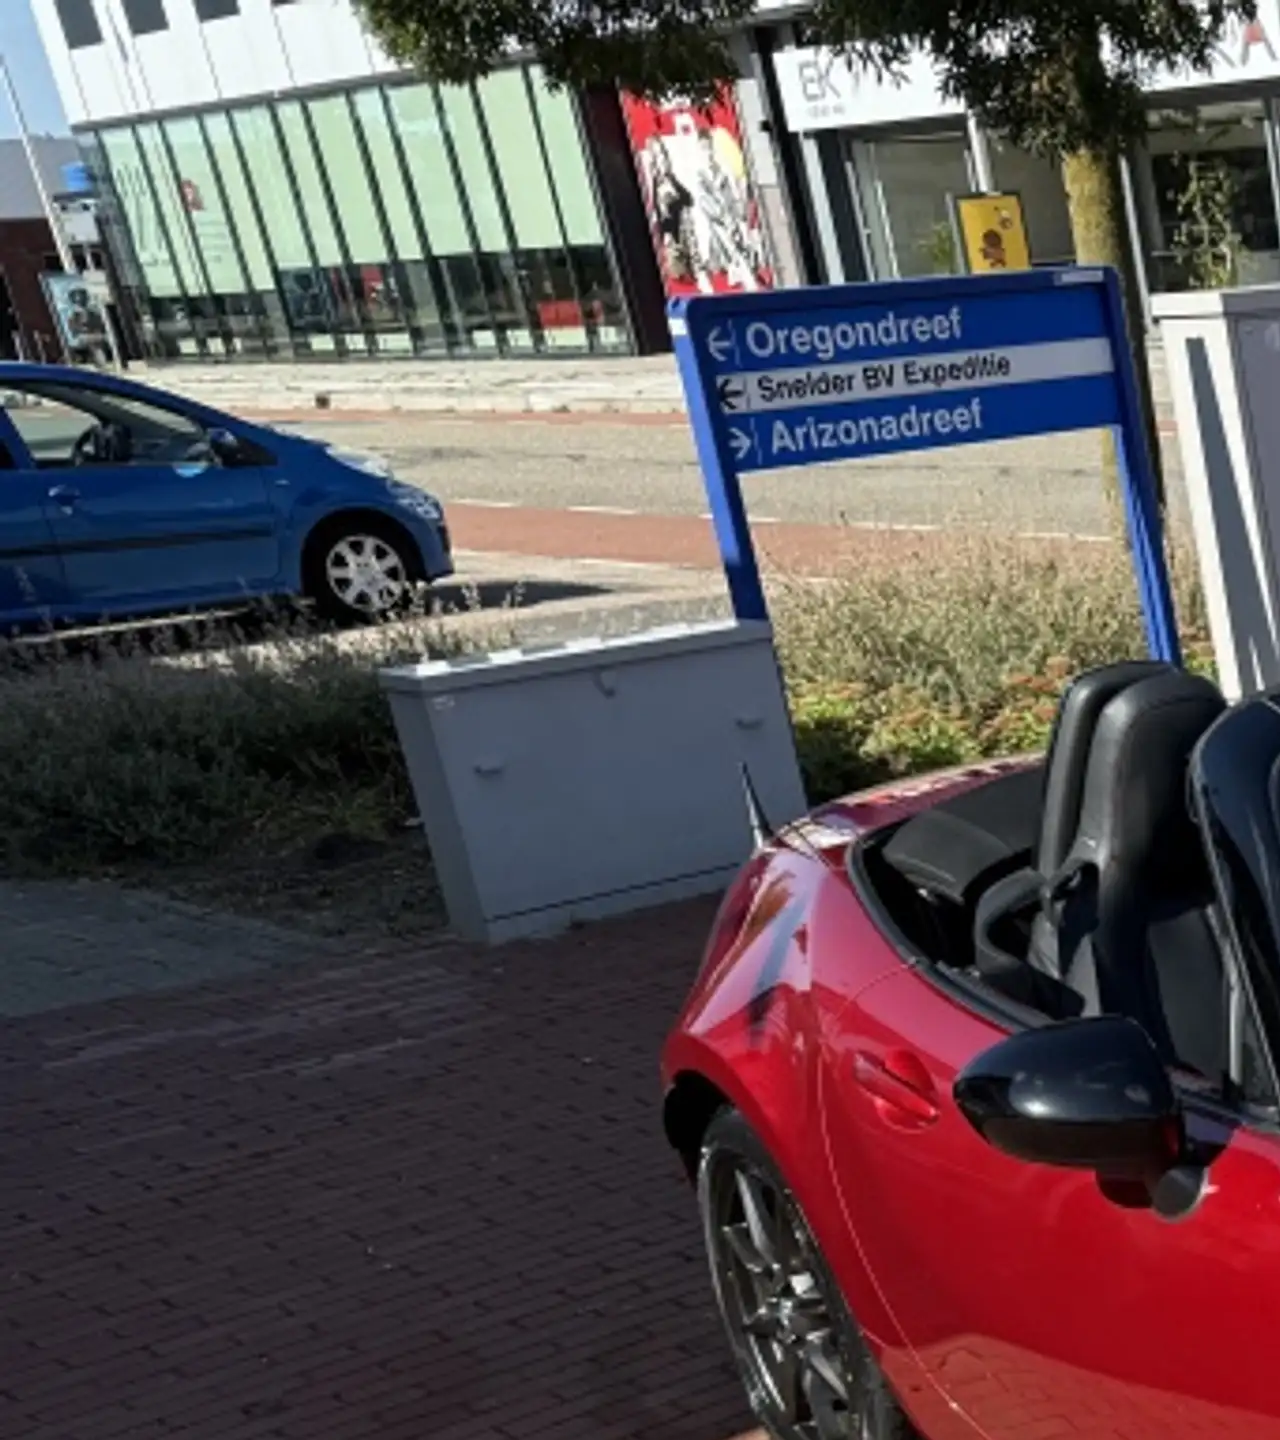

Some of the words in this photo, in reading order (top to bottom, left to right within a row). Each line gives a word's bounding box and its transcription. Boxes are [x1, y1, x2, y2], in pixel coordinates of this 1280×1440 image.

[746, 307, 962, 361] Oregondreef
[757, 371, 856, 402] Snelder
[862, 362, 895, 390] BV
[904, 352, 1011, 386] Expeditie
[771, 397, 983, 455] Arizonadreef
